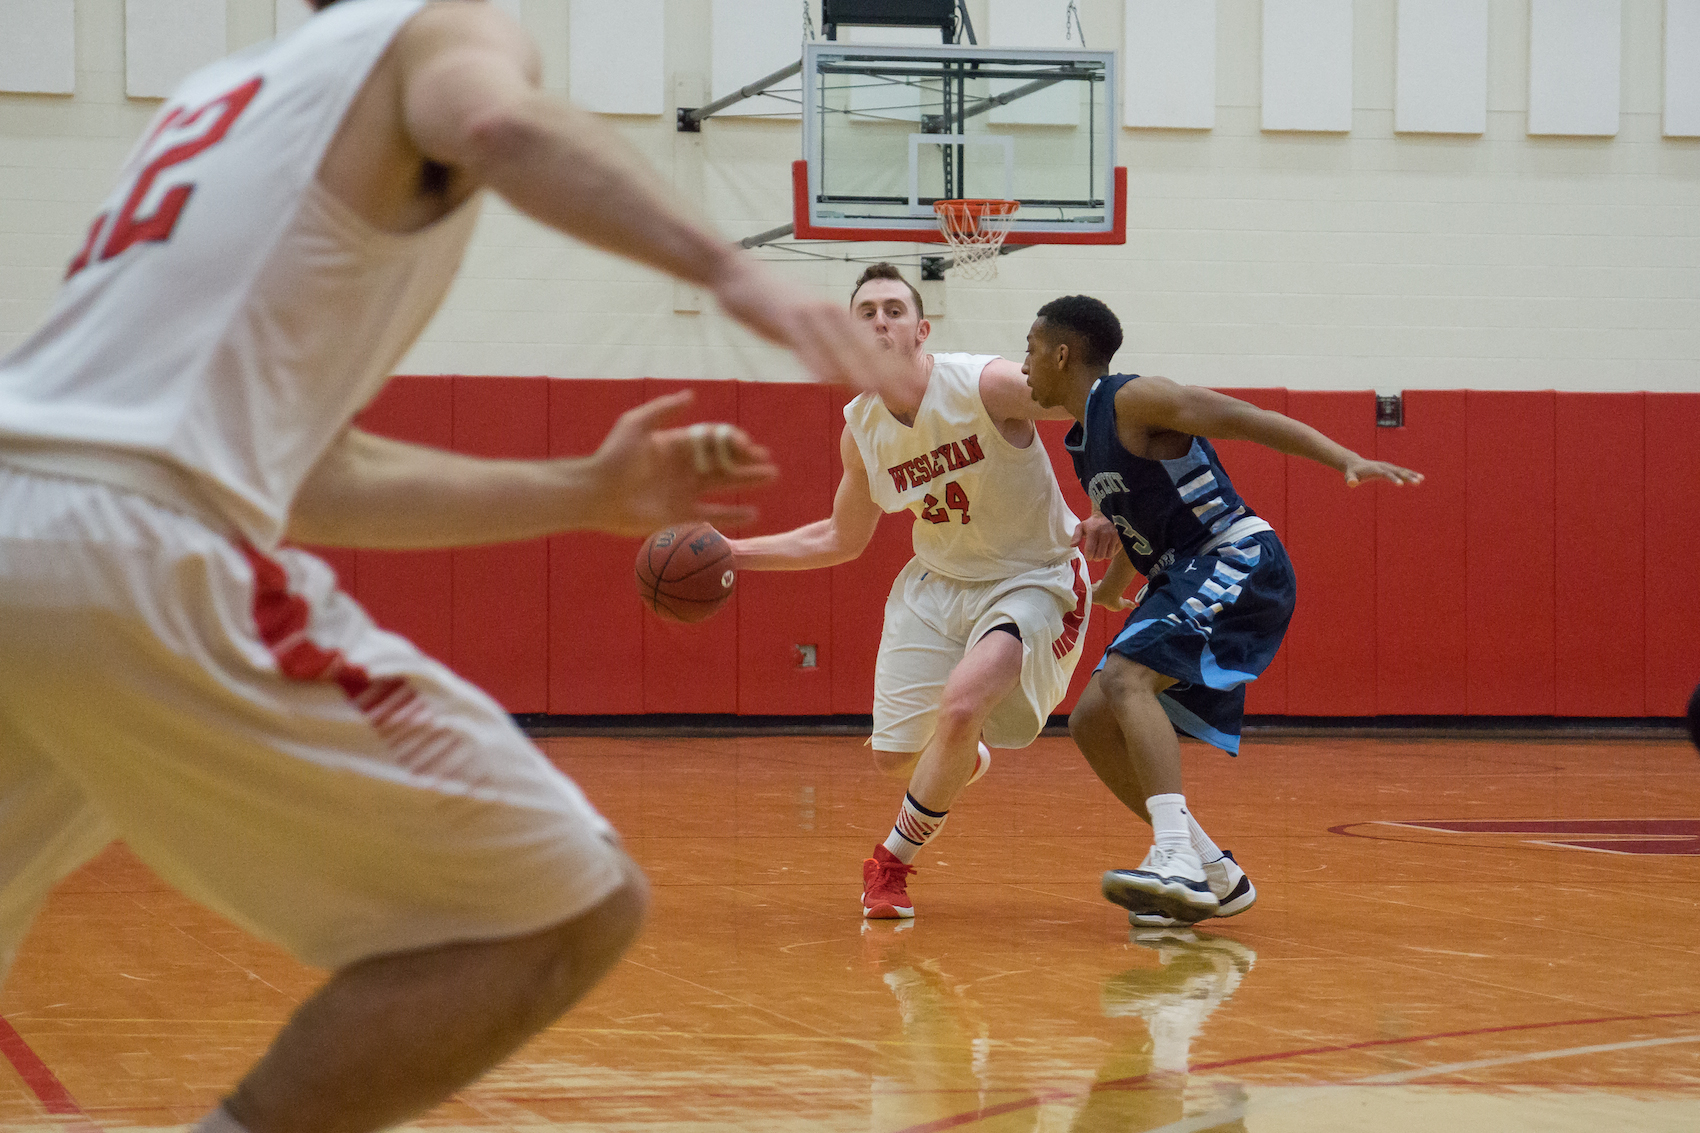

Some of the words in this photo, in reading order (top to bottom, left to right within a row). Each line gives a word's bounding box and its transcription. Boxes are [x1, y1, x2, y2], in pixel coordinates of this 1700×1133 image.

[887, 433, 985, 494] WESLEYAN
[921, 480, 971, 525] 24
[1111, 514, 1154, 556] 3
